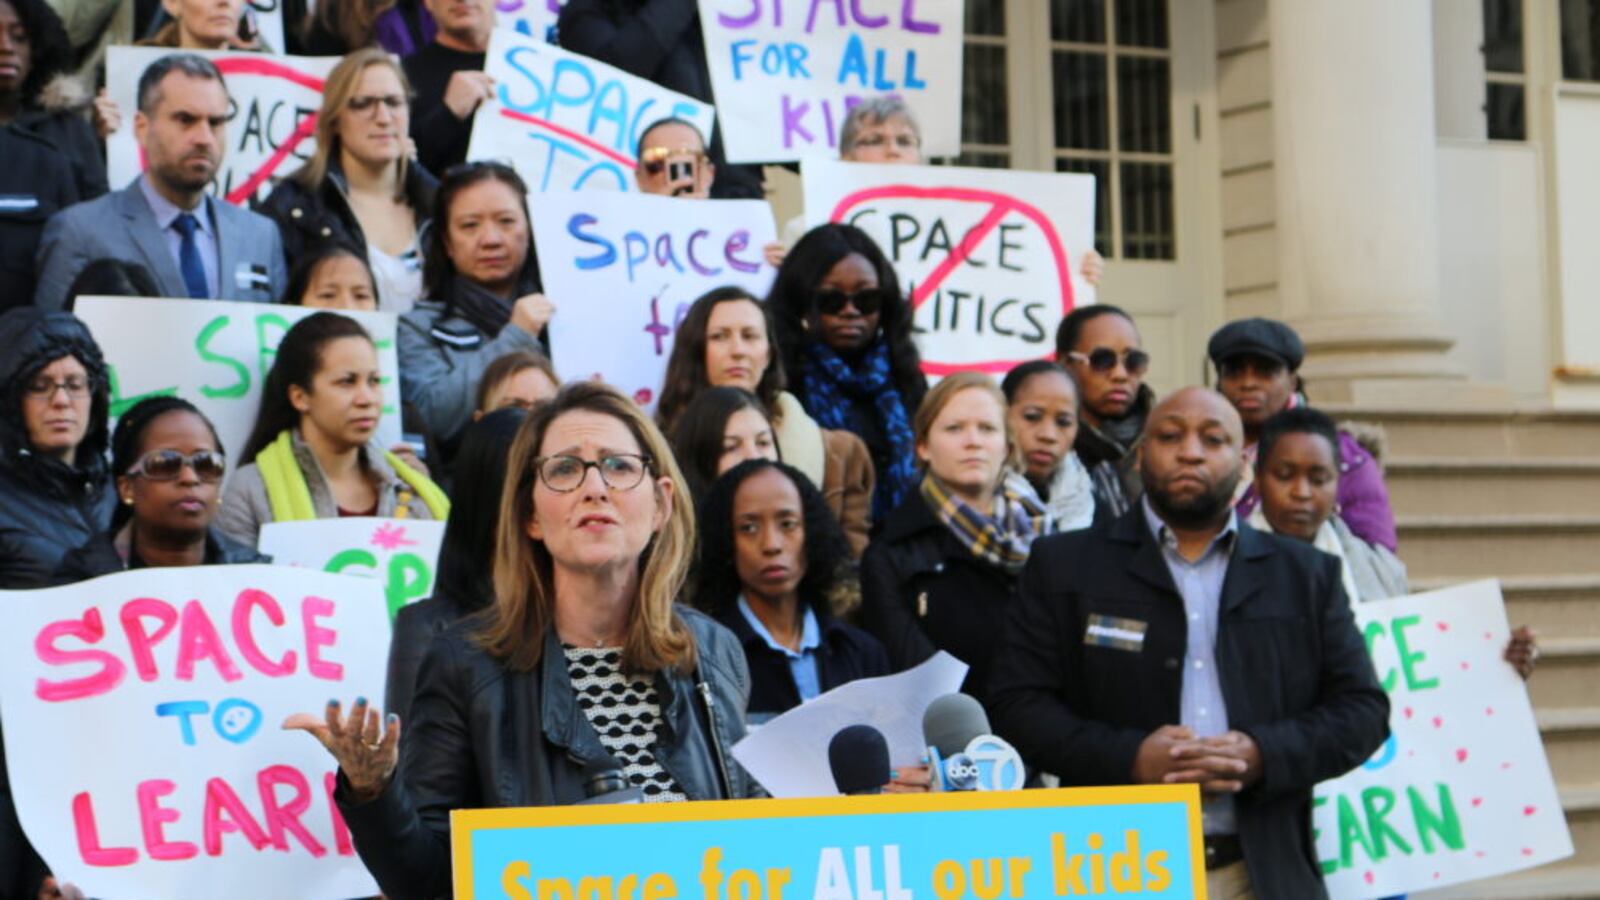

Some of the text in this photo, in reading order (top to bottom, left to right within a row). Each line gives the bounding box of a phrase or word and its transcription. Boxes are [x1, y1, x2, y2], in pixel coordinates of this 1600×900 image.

[729, 33, 926, 90] FOR ALL
[566, 213, 761, 282] Space
[34, 588, 344, 702] SPACE
[155, 697, 263, 745] TO
[700, 846, 792, 900] for
[813, 845, 912, 900] ALL
[931, 857, 1032, 900] our
[1051, 830, 1171, 896] kids
